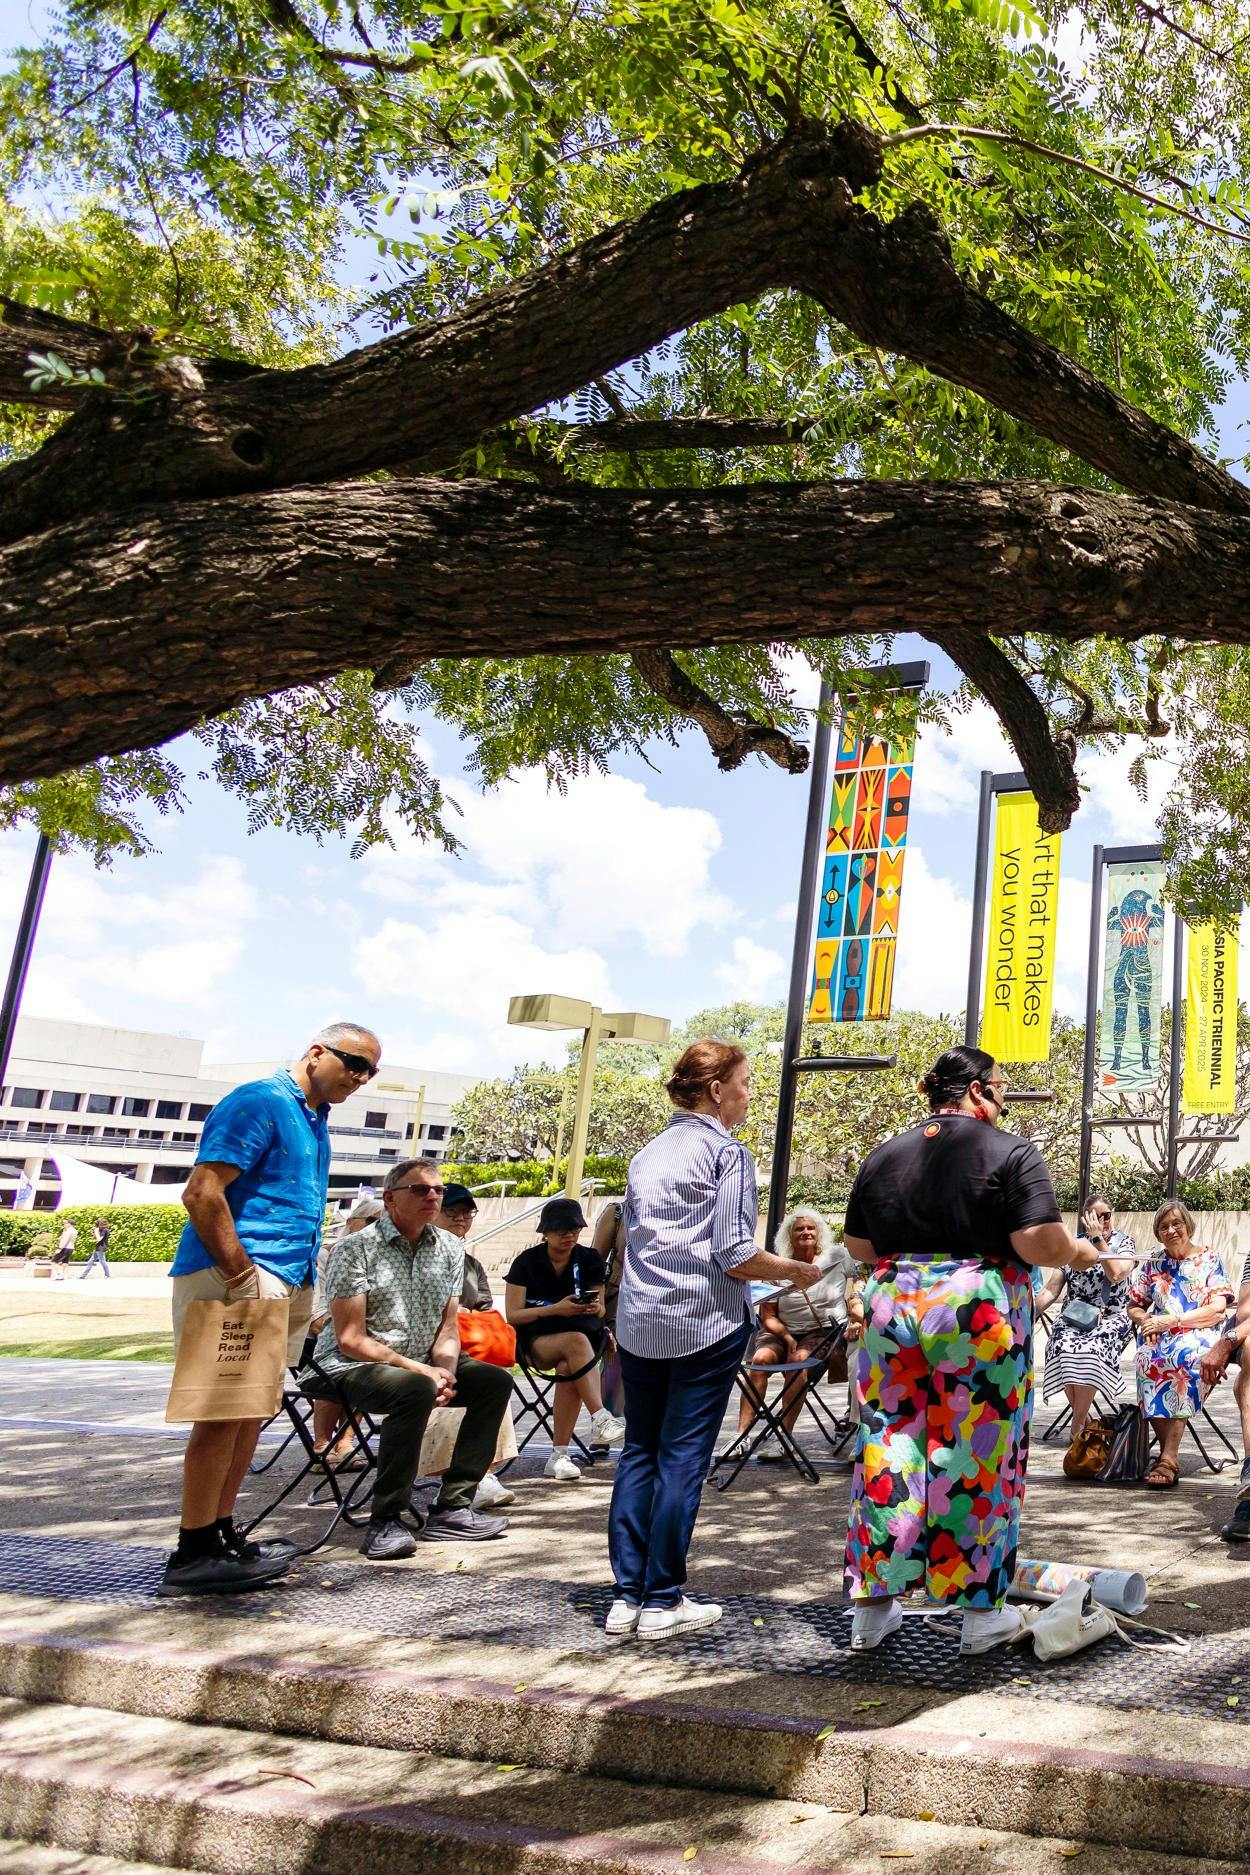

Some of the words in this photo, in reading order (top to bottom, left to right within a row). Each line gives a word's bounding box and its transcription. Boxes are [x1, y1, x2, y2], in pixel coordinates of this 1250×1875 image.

[999, 847, 1021, 896] you
[1029, 869, 1055, 927] that
[994, 904, 1018, 1013] wonder
[1201, 944, 1209, 957] 30
[1200, 958, 1209, 978] NOV
[1022, 935, 1048, 1027] makes
[1213, 960, 1225, 1014] PACIFIC
[1200, 980, 1209, 1003] 2024
[1199, 1016, 1207, 1027] 27
[1198, 1029, 1207, 1047] APR
[1197, 1049, 1206, 1072] 2025
[1210, 1017, 1224, 1090] TRIENNIAL
[1187, 1101, 1206, 1109] FREE
[1206, 1101, 1229, 1109] ENTRY
[222, 1321, 245, 1330] Eat
[218, 1342, 250, 1351] Read
[221, 1332, 255, 1341] Sleep
[216, 1352, 251, 1362] Local
